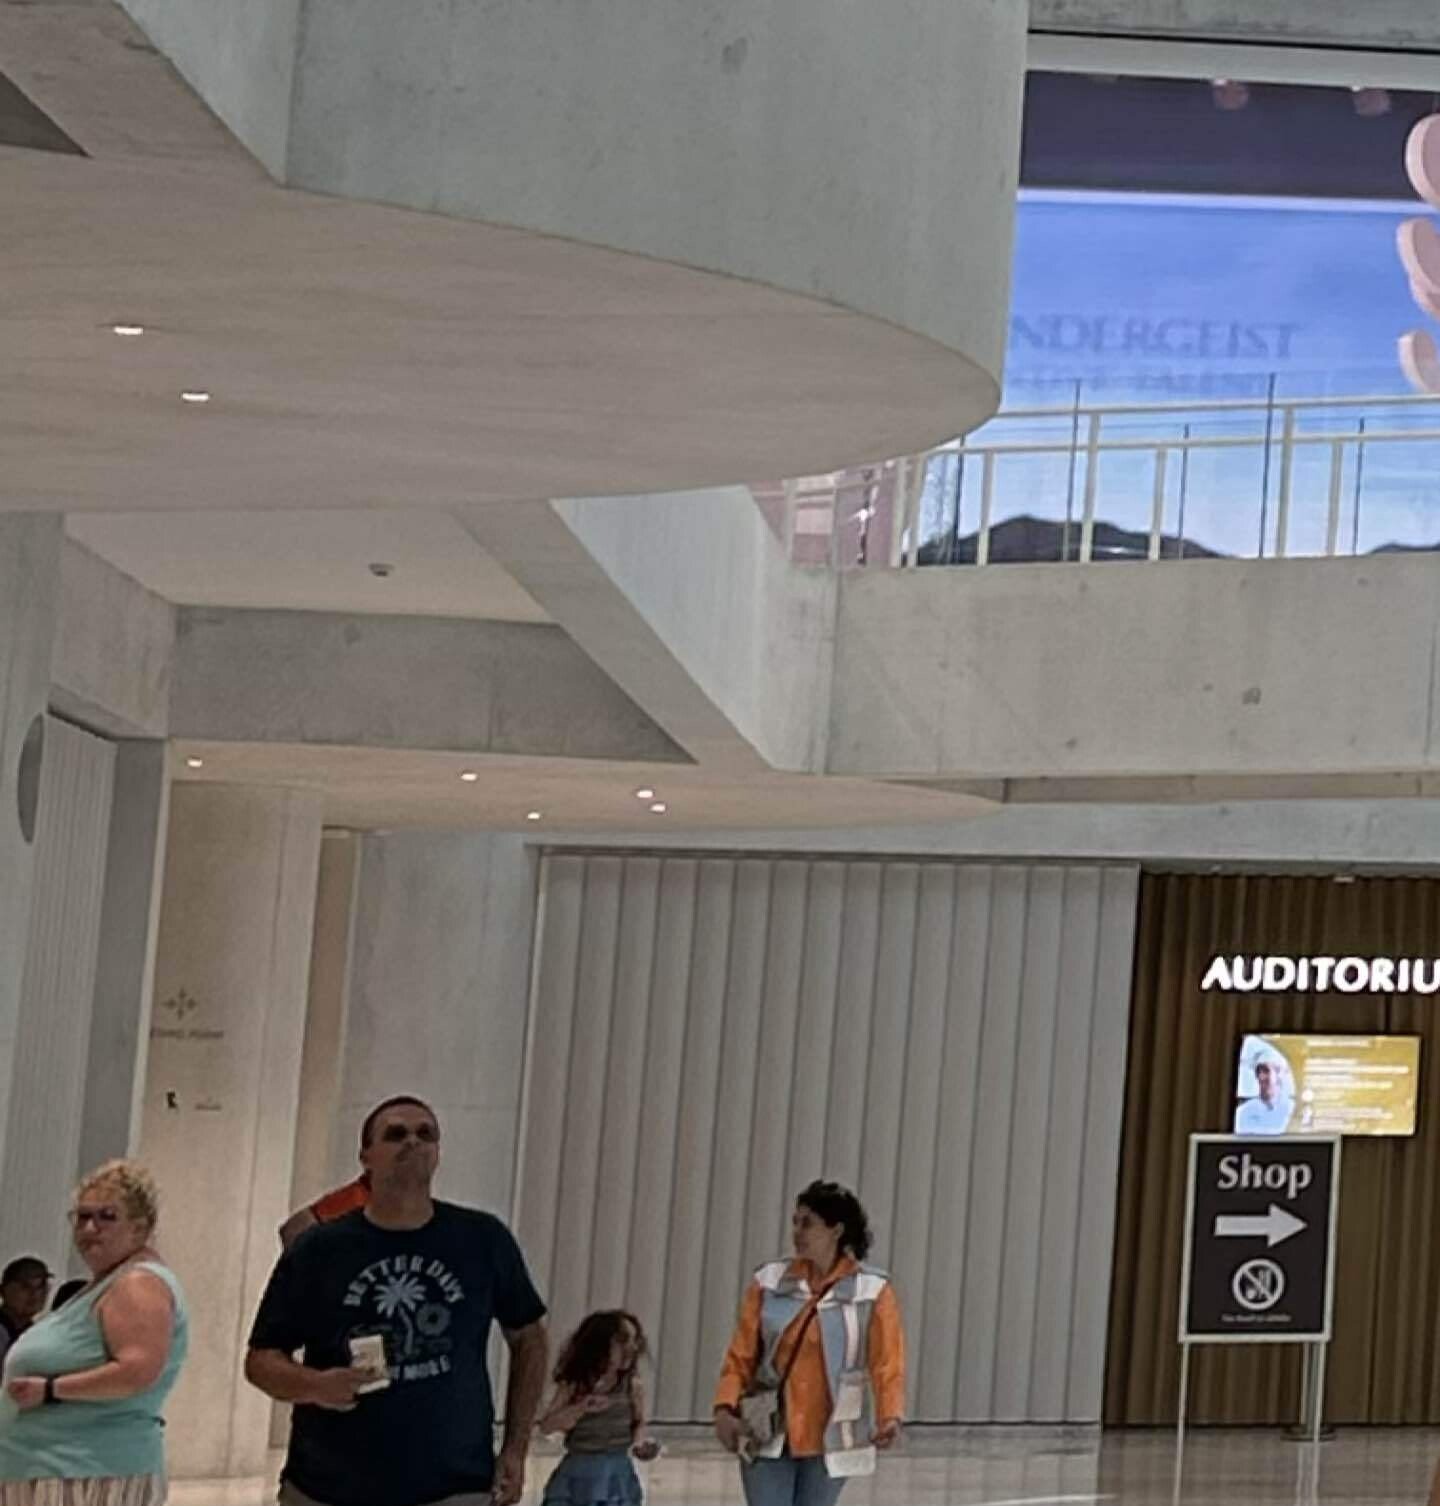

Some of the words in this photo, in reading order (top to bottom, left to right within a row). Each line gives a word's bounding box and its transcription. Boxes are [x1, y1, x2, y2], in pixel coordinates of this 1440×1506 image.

[1216, 1154, 1312, 1199] Shop
[341, 1253, 424, 1308] BETTER
[425, 1259, 466, 1304] DAYS
